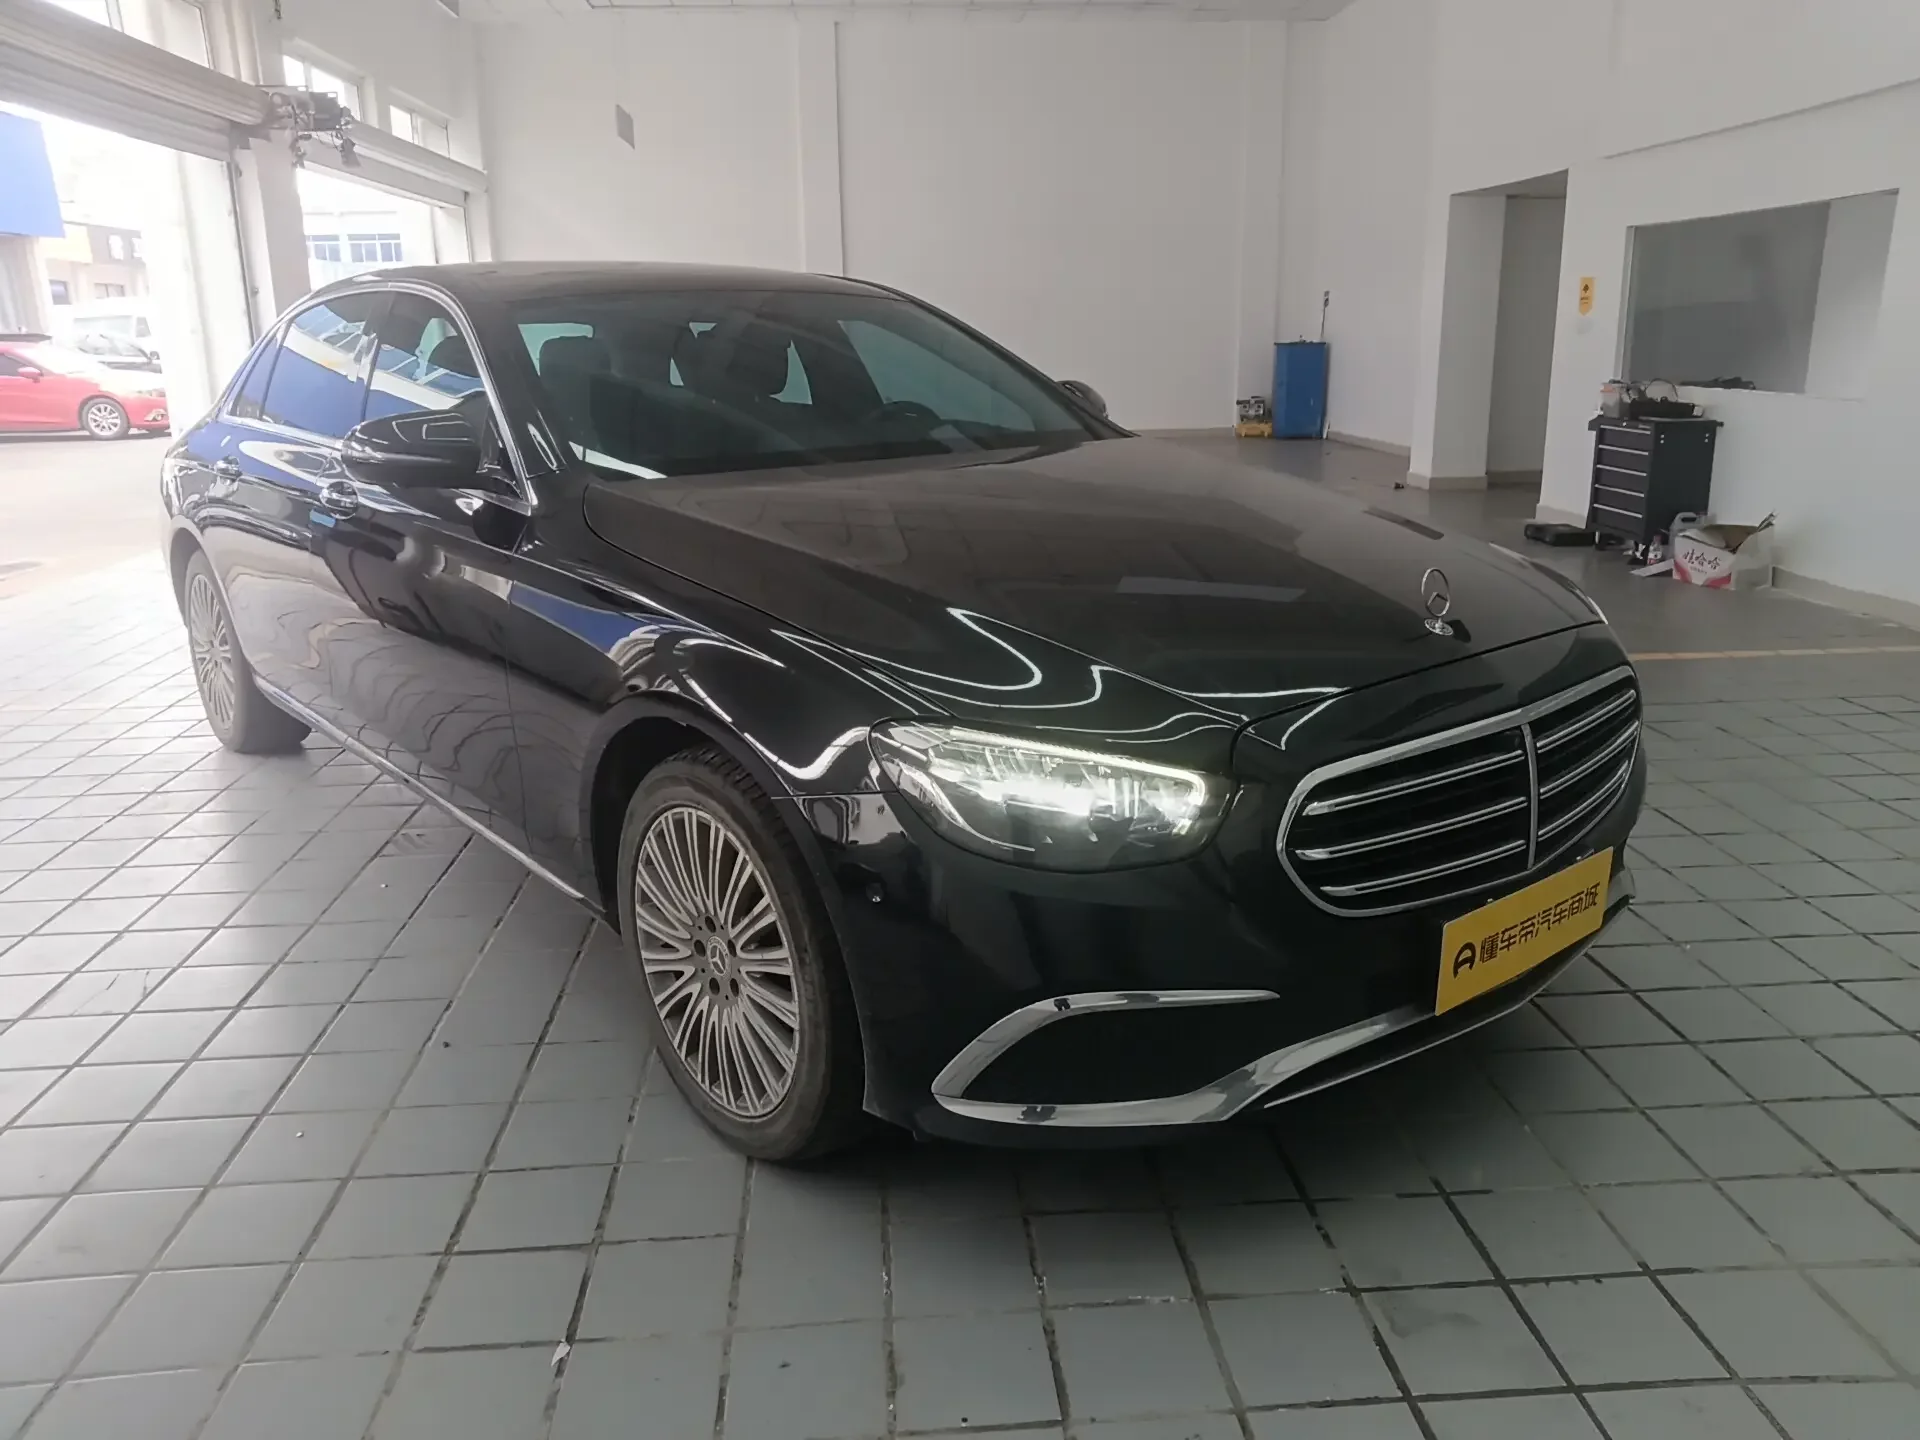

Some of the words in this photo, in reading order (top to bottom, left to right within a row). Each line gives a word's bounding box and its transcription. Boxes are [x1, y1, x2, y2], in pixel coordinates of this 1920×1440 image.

[1479, 882, 1601, 963] 懂车帝汽车商城
